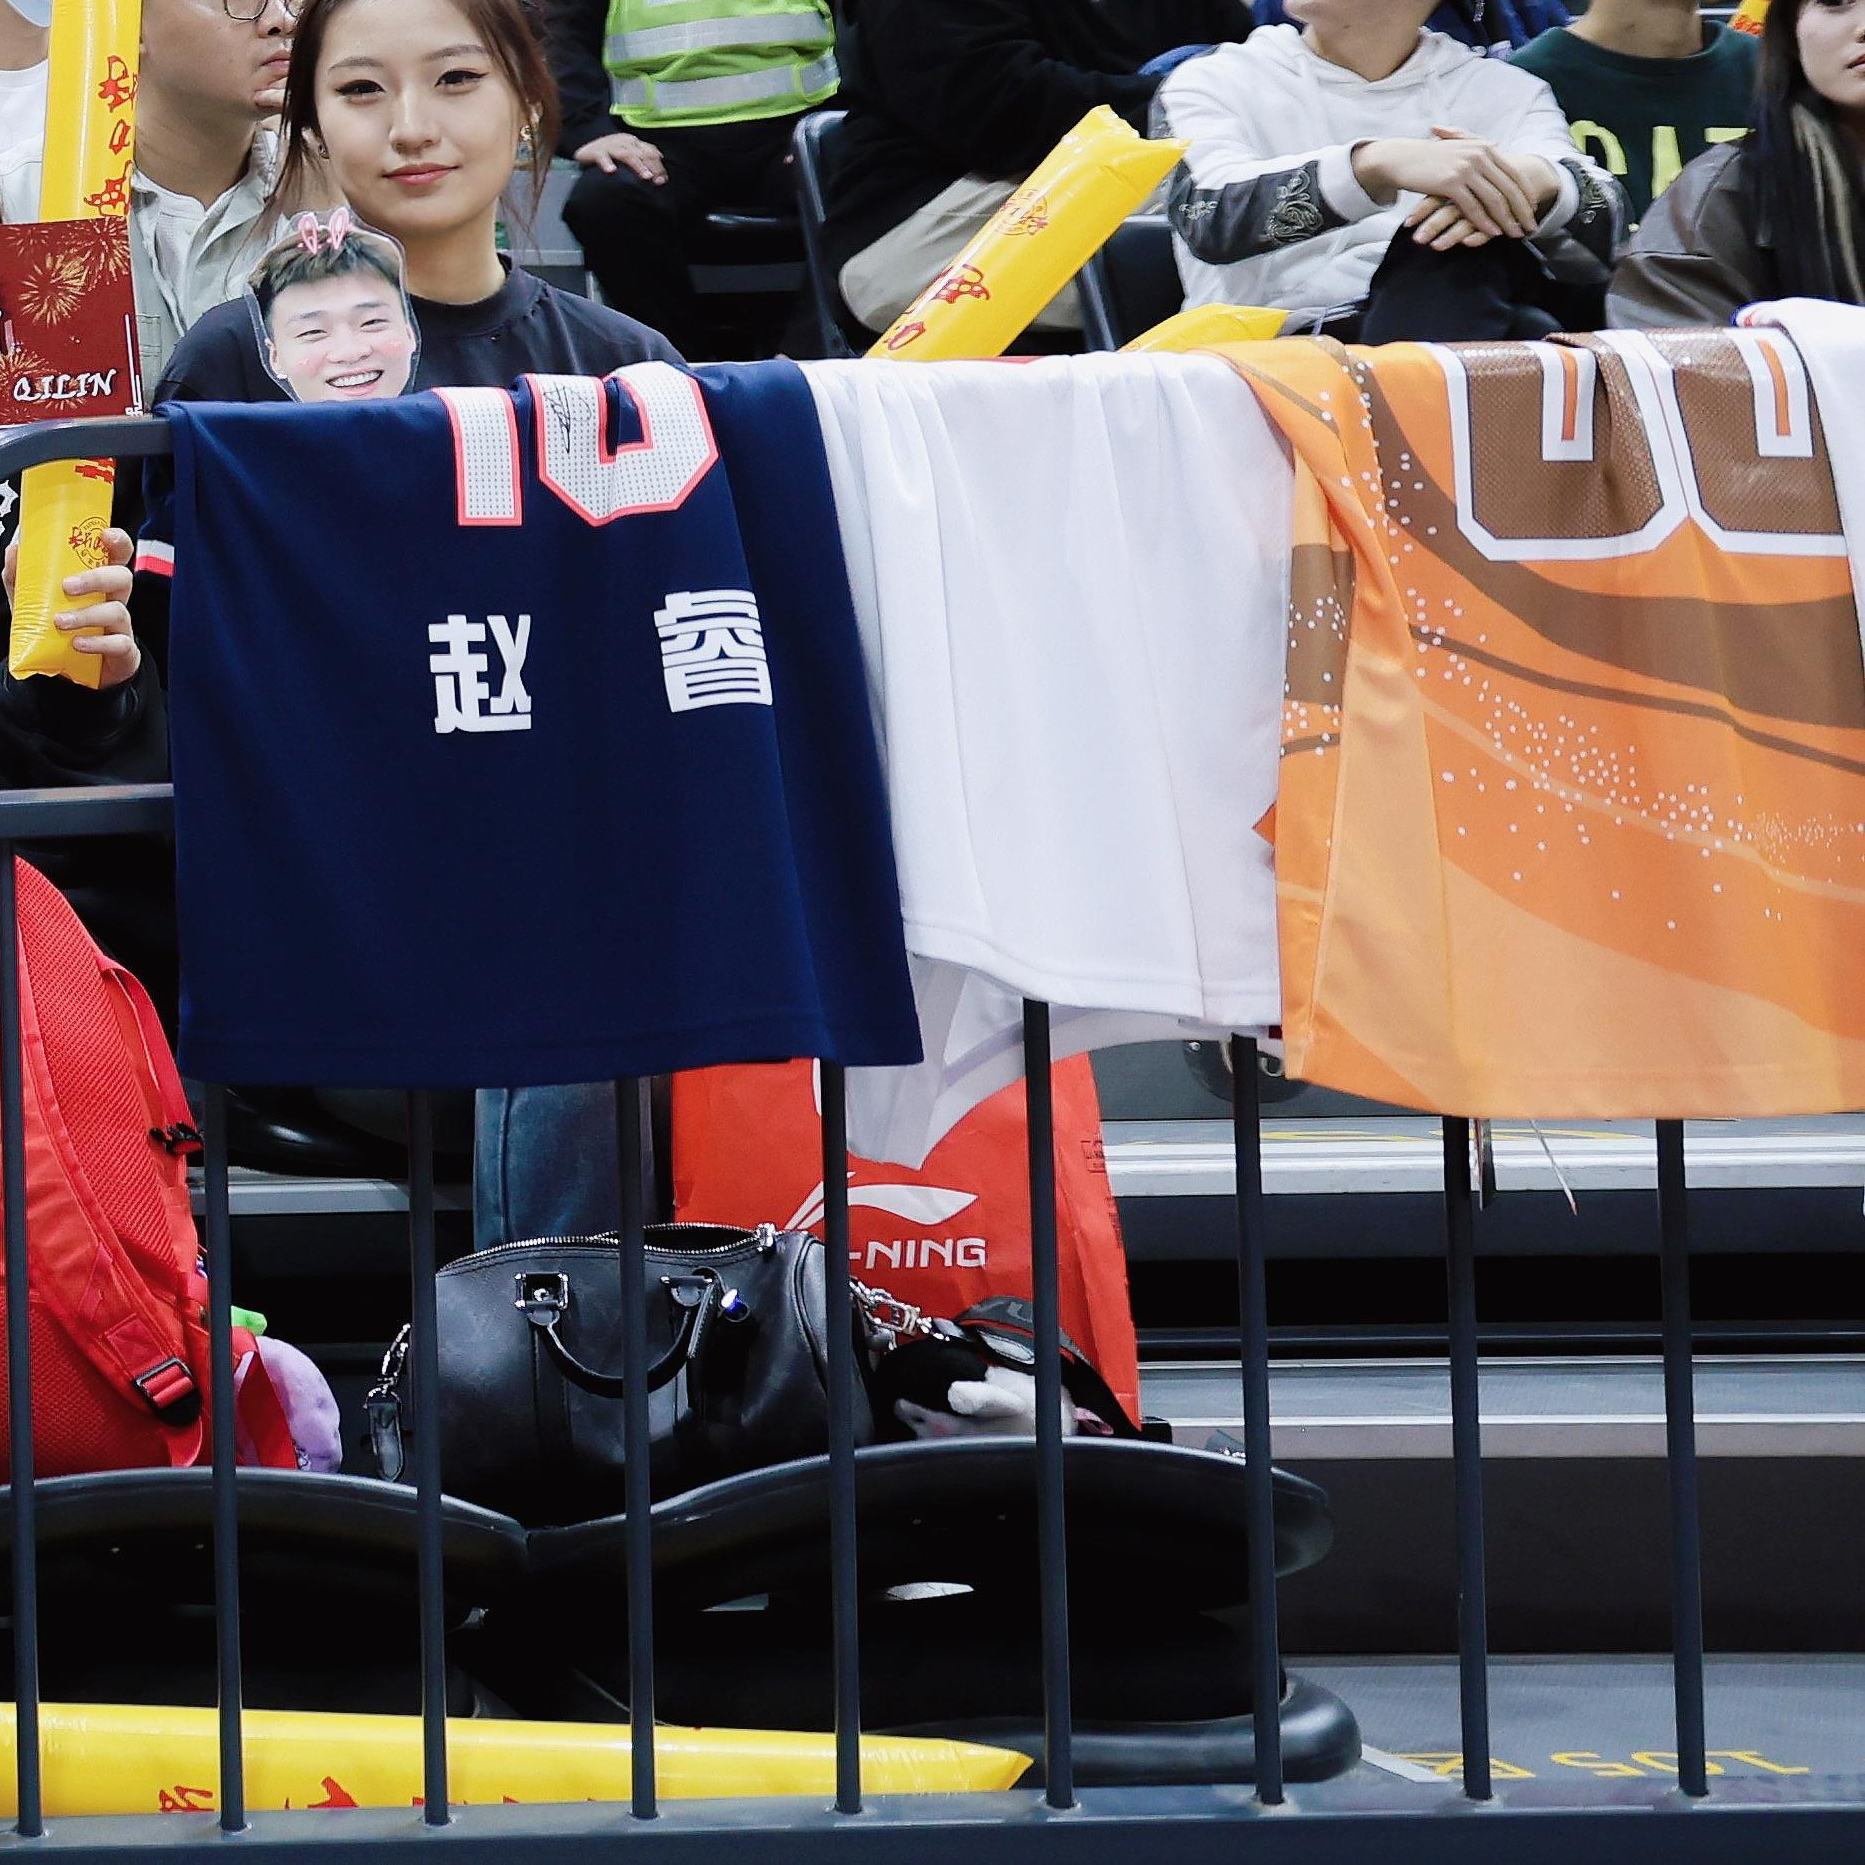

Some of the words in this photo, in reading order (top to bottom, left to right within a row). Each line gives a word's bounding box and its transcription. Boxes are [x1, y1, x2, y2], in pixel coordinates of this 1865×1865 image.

[12, 366, 119, 405] QILIN
[427, 587, 774, 735] 赵睿
[848, 1236, 987, 1271] -NING
